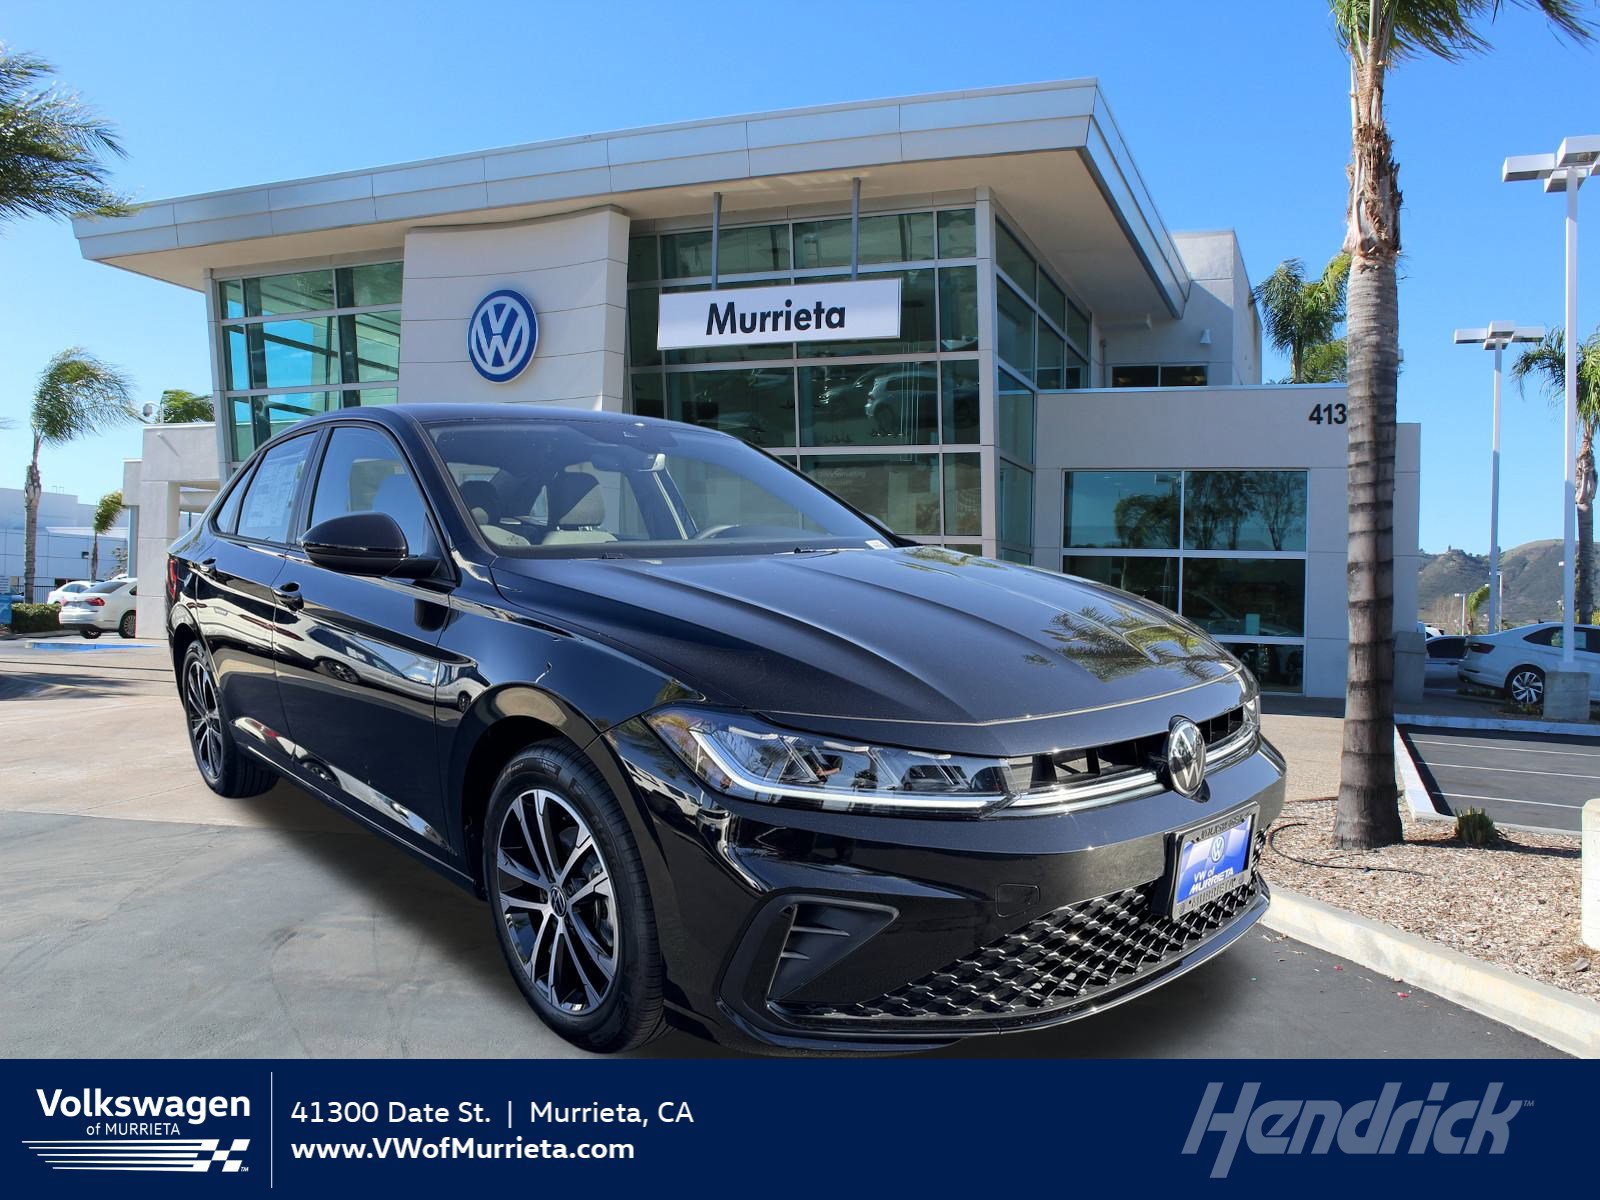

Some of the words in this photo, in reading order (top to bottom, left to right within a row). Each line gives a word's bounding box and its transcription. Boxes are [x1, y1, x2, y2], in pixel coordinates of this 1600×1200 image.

[705, 298, 846, 336] Murrieta
[1188, 866, 1234, 895] MURRIETA
[1193, 870, 1206, 881] VW
